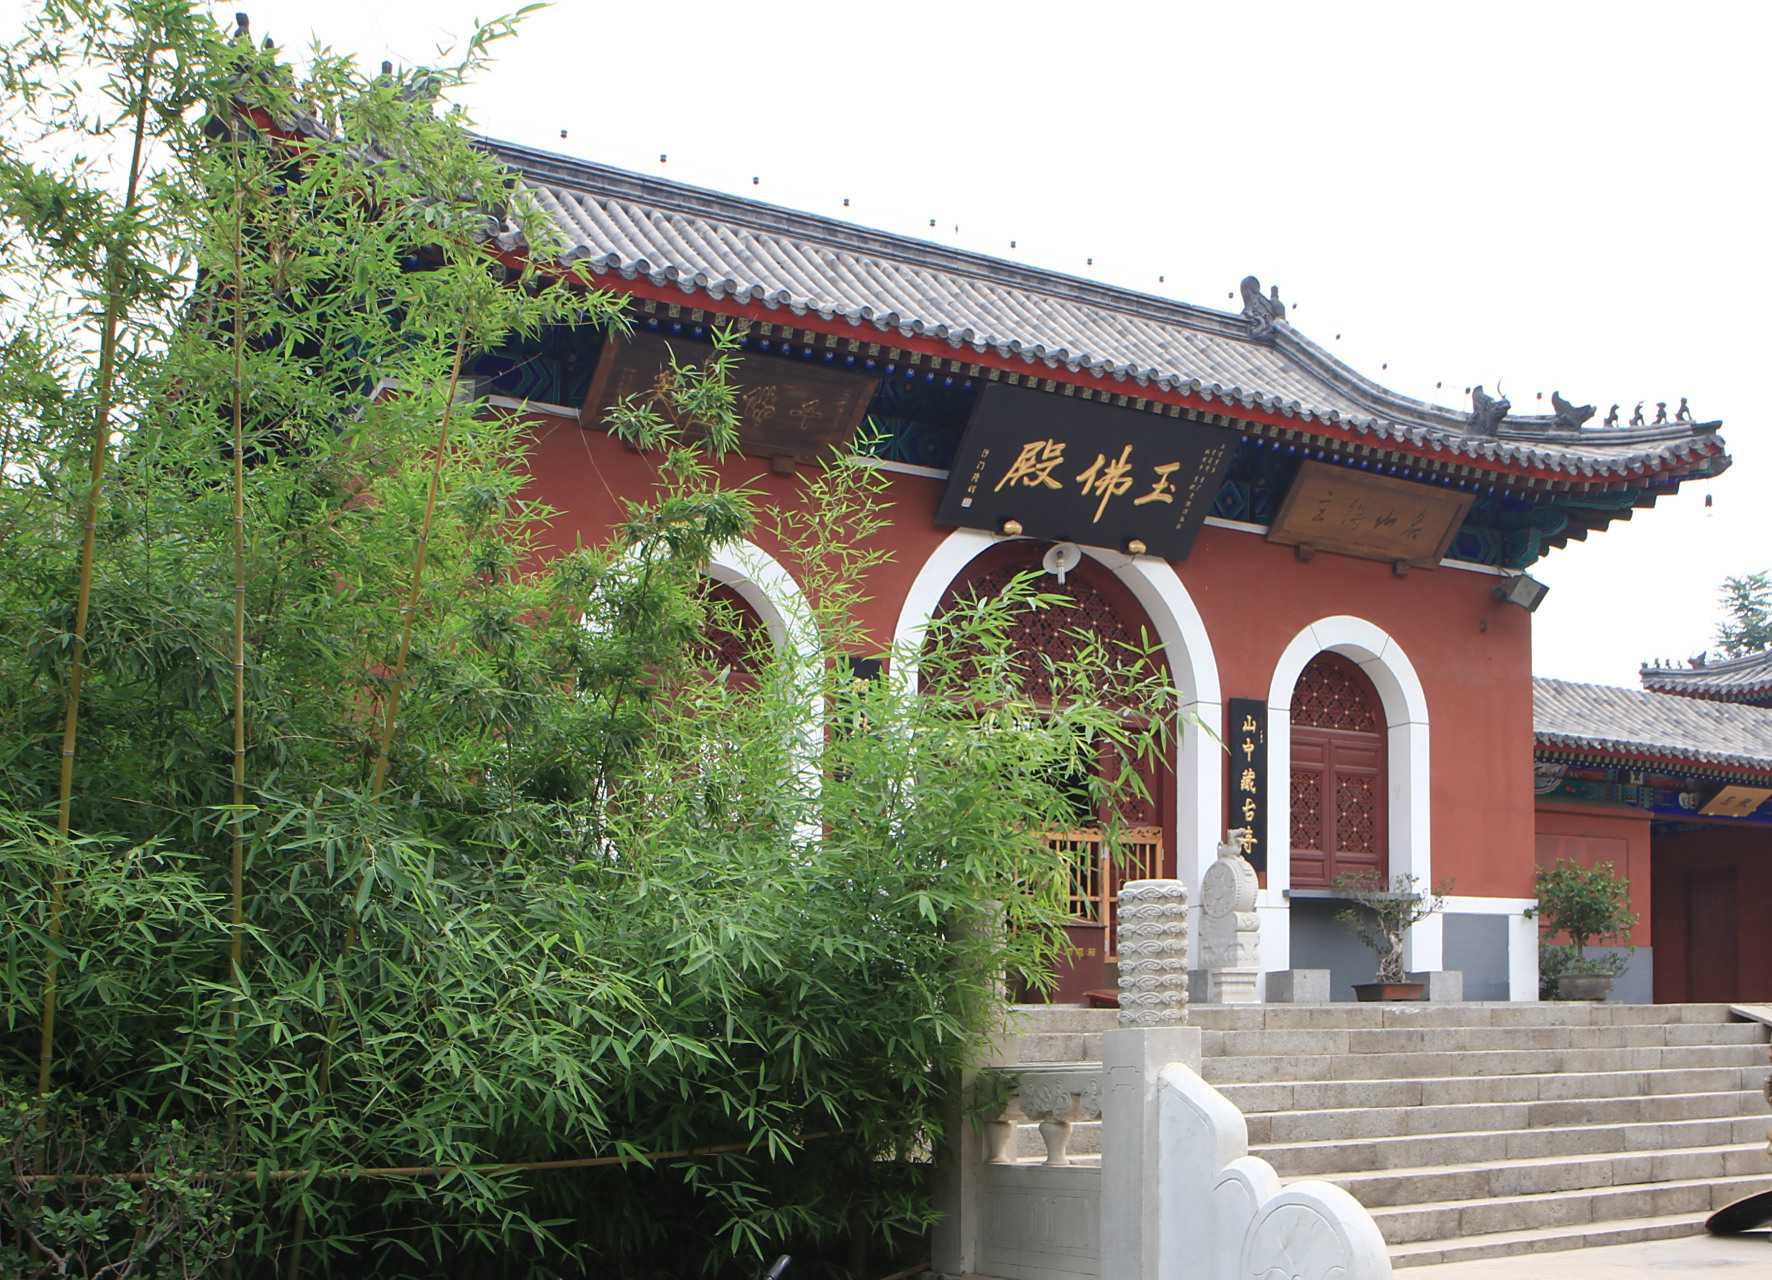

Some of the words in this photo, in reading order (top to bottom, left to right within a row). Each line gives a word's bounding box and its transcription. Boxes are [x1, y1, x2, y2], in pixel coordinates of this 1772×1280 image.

[994, 438, 1180, 524] 玉佛殿
[1240, 715, 1258, 854] 山中藏古寺
